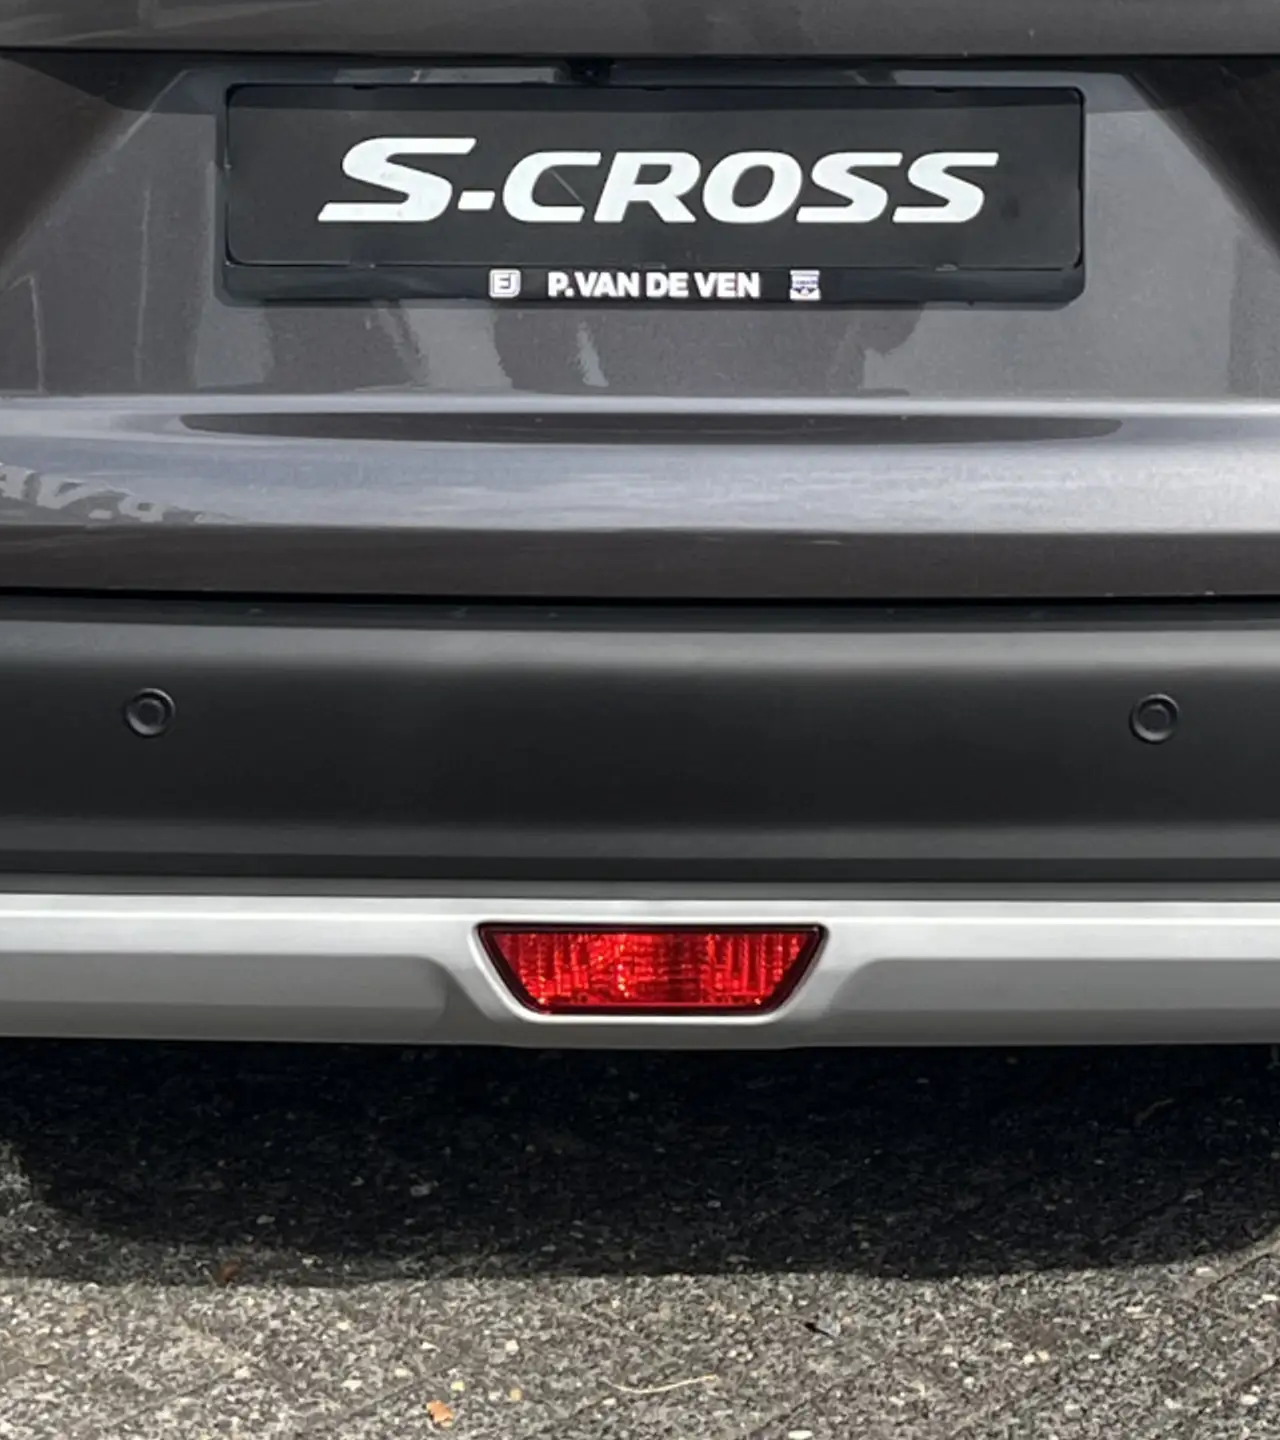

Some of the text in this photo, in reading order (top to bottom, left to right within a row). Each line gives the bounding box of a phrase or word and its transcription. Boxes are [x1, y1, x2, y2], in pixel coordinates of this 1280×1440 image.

[317, 136, 1001, 225] S-CROSS
[646, 271, 690, 298] DE
[692, 271, 760, 298] VEN
